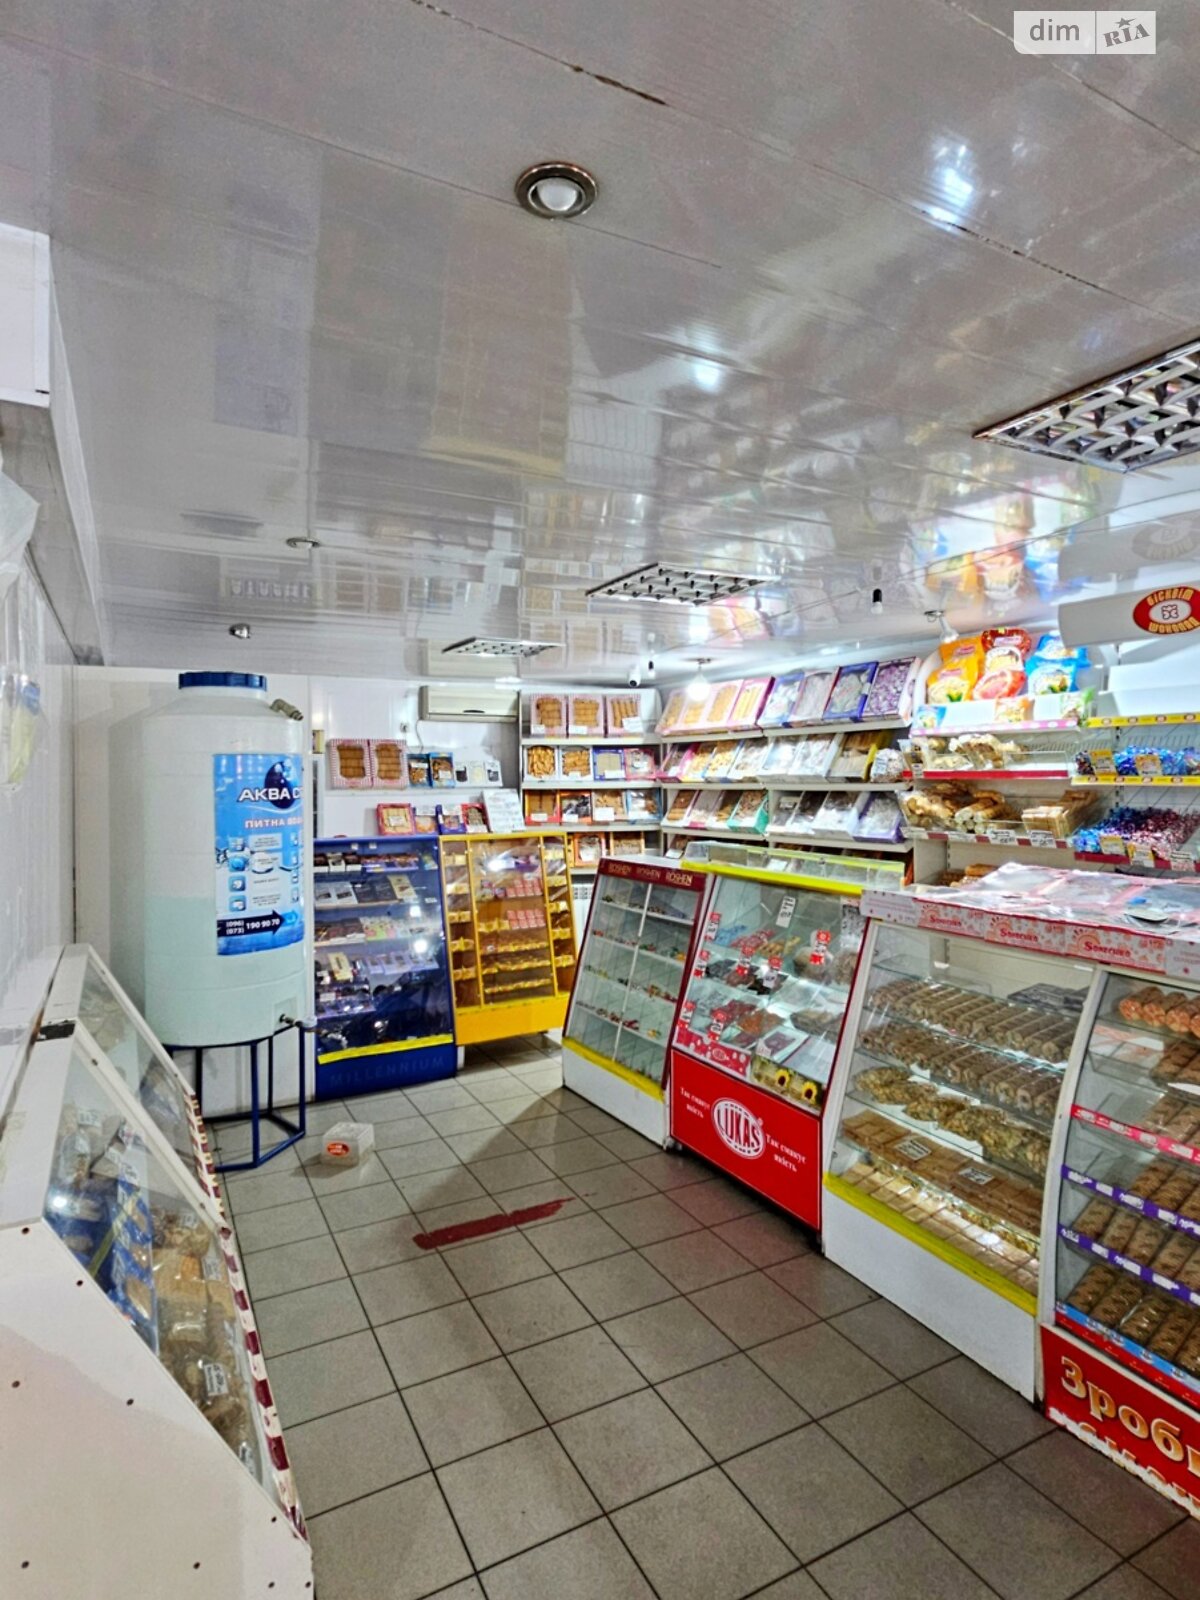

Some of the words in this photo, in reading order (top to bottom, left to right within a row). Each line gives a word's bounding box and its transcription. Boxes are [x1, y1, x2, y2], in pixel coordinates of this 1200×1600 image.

[244, 816, 285, 829] ПИТНА
[330, 1056, 445, 1087] MILLENNIUM
[716, 1104, 762, 1153] LUKAS
